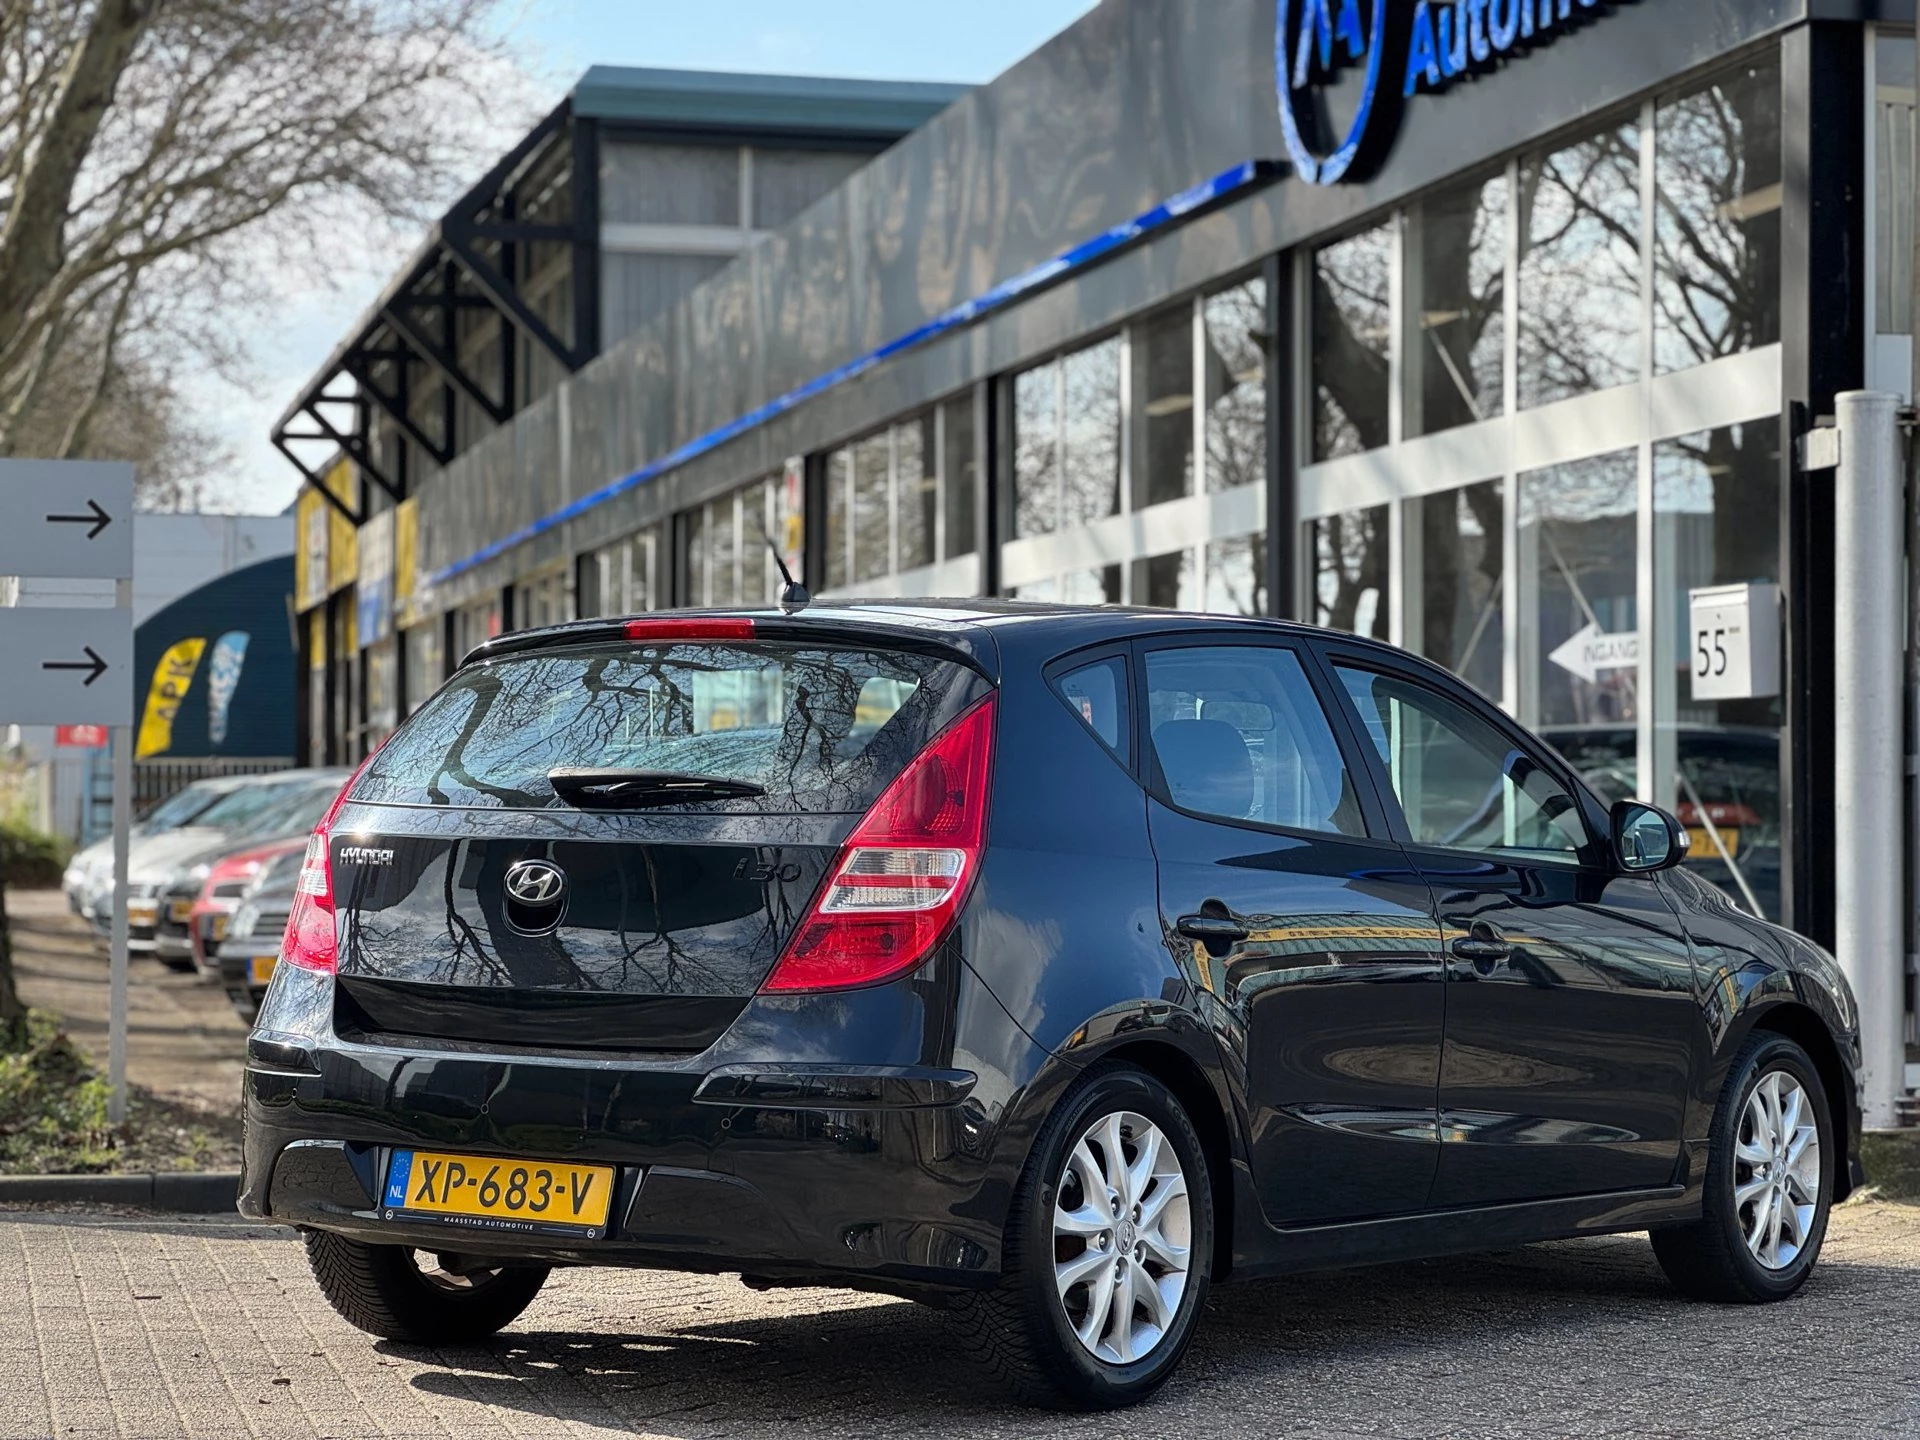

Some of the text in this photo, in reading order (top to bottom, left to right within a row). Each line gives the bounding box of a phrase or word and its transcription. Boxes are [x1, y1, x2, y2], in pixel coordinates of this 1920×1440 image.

[1697, 628, 1728, 678] 55
[156, 654, 193, 721] APK
[340, 847, 394, 866] HYUNDAI
[388, 1185, 404, 1199] NL
[414, 1159, 594, 1216] XP-683-V
[443, 1216, 534, 1231] MAASSTAD AUTOMOTIVE
